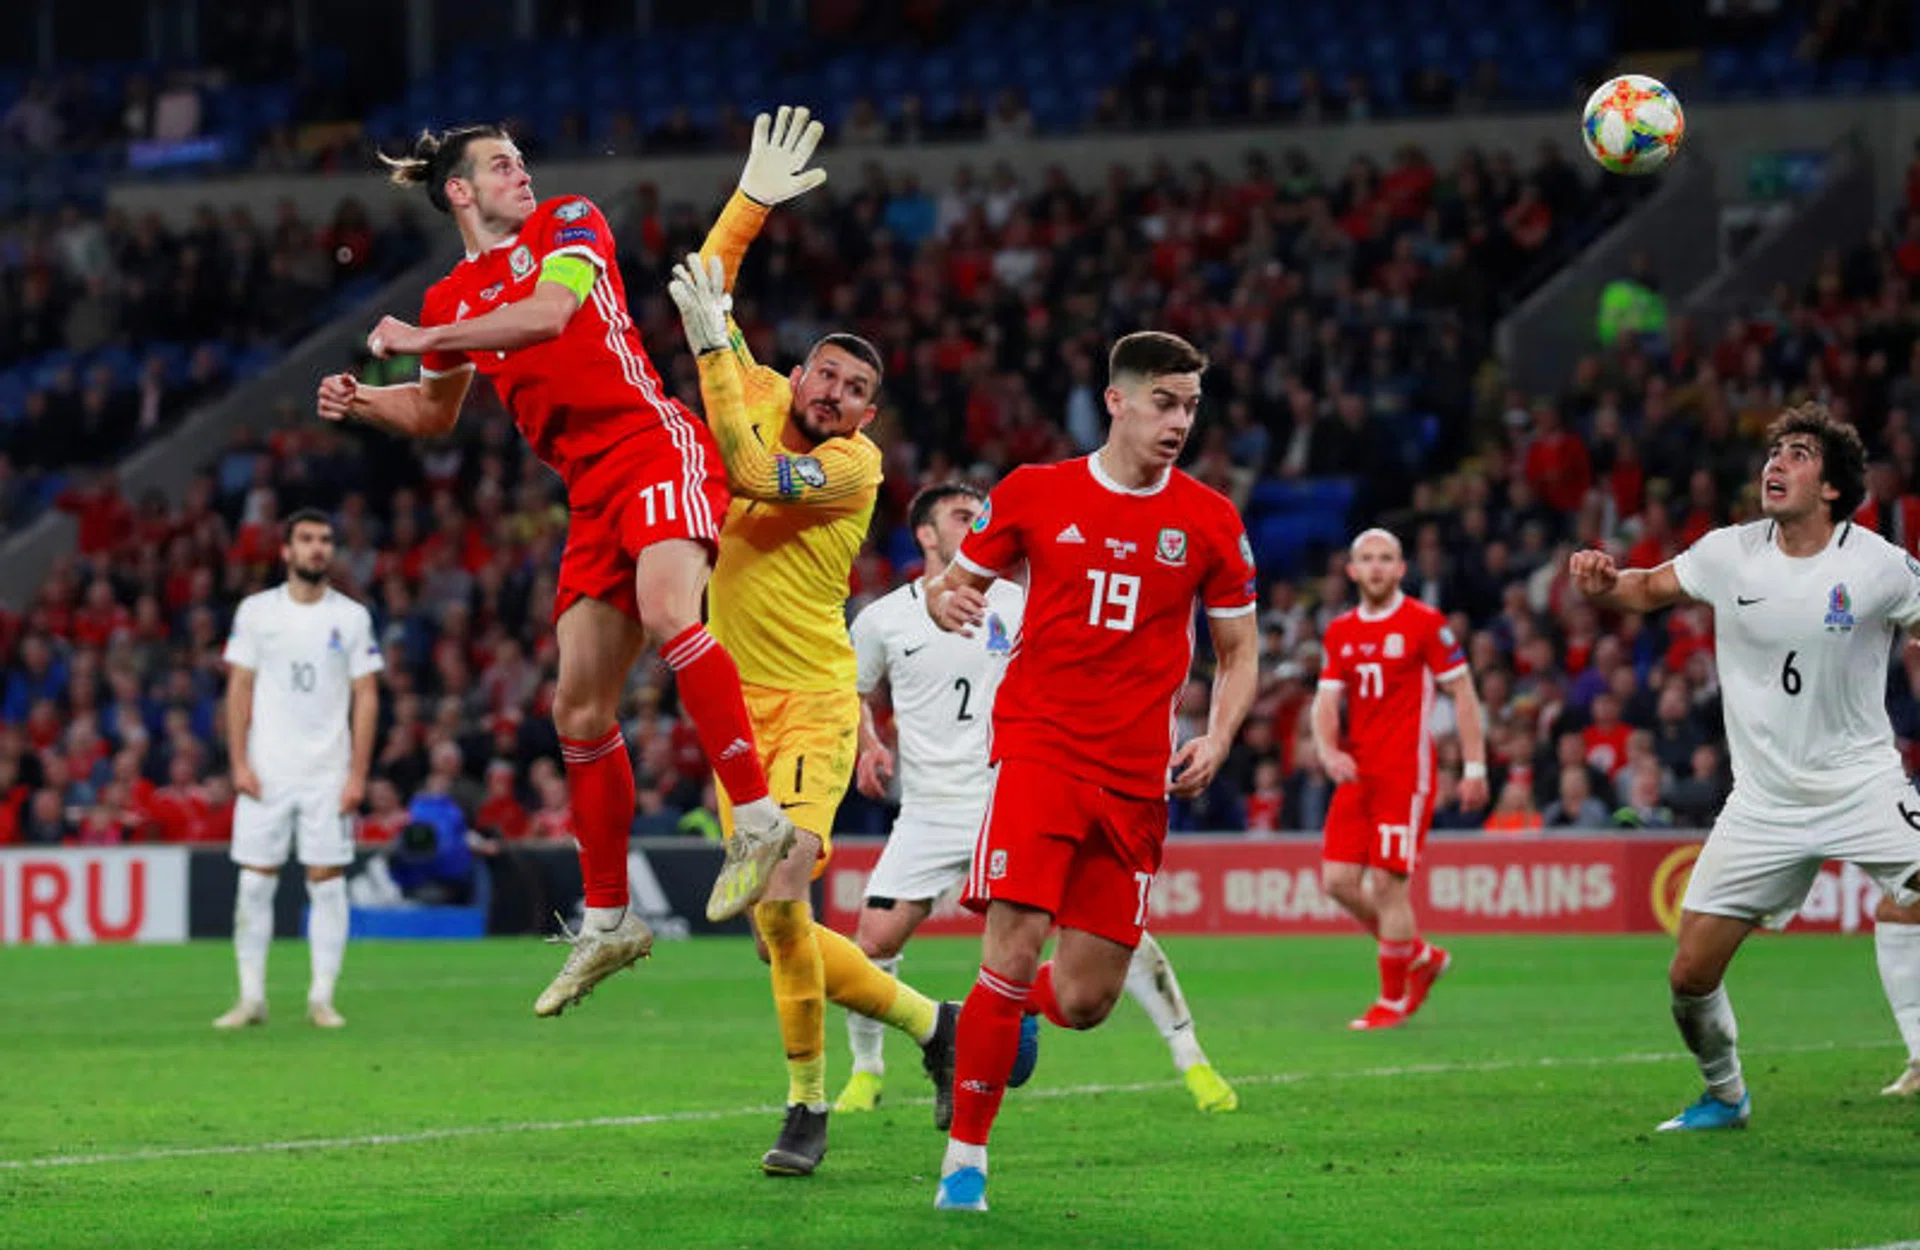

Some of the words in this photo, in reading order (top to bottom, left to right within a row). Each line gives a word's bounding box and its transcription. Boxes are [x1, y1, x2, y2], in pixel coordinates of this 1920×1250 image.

[639, 480, 676, 527] 11
[1086, 568, 1142, 632] 19
[290, 660, 316, 693] 10
[1782, 650, 1802, 696] 6
[955, 677, 973, 721] 2
[795, 754, 805, 793] 1
[1134, 871, 1153, 926] 1
[1430, 863, 1615, 917] BRAINS
